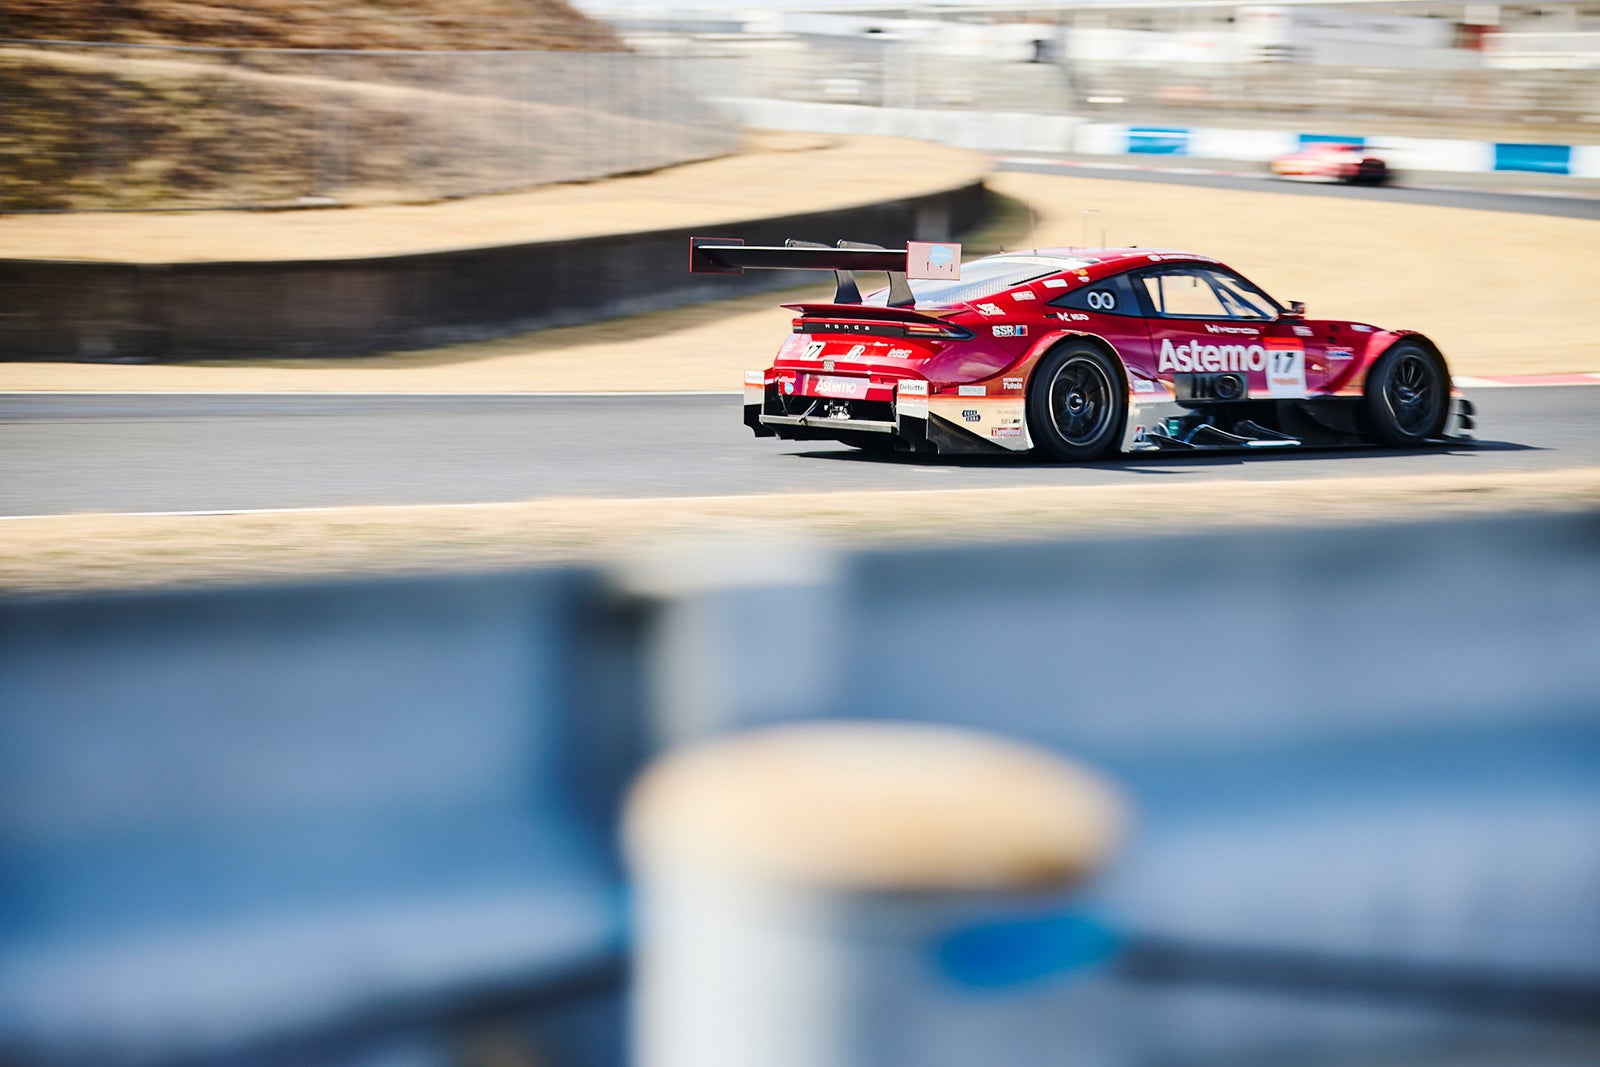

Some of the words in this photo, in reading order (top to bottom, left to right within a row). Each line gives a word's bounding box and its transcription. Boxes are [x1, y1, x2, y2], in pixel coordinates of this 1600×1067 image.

[803, 344, 822, 359] 17
[1158, 338, 1266, 373] Astemo
[1273, 351, 1294, 373] 17
[814, 378, 857, 394] Astemo
[899, 383, 925, 392] Deloitte
